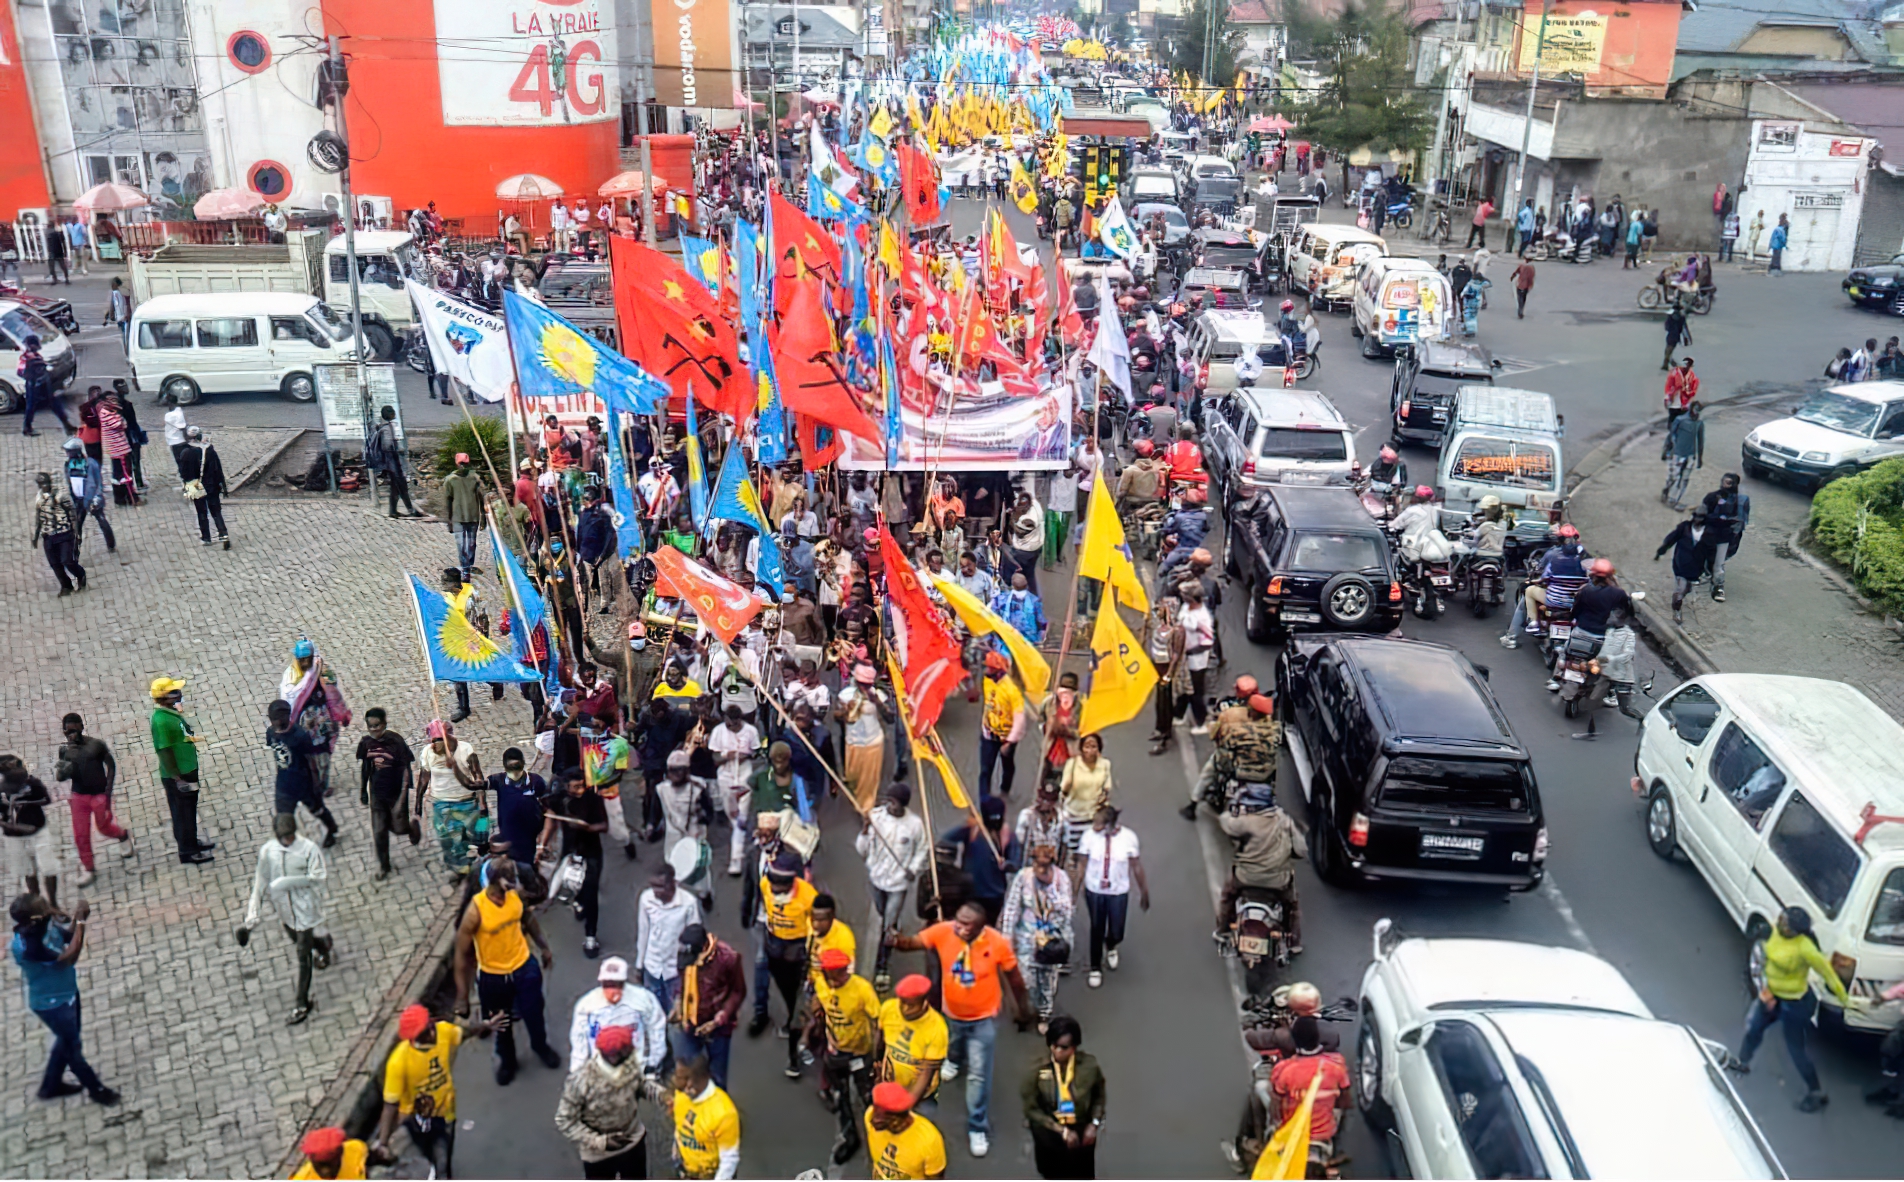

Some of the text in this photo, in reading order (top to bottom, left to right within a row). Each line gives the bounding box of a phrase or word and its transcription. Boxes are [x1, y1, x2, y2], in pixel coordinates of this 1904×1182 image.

[512, 11, 543, 34] LA
[678, 13, 698, 106] vodacom
[508, 39, 607, 117] 4G
